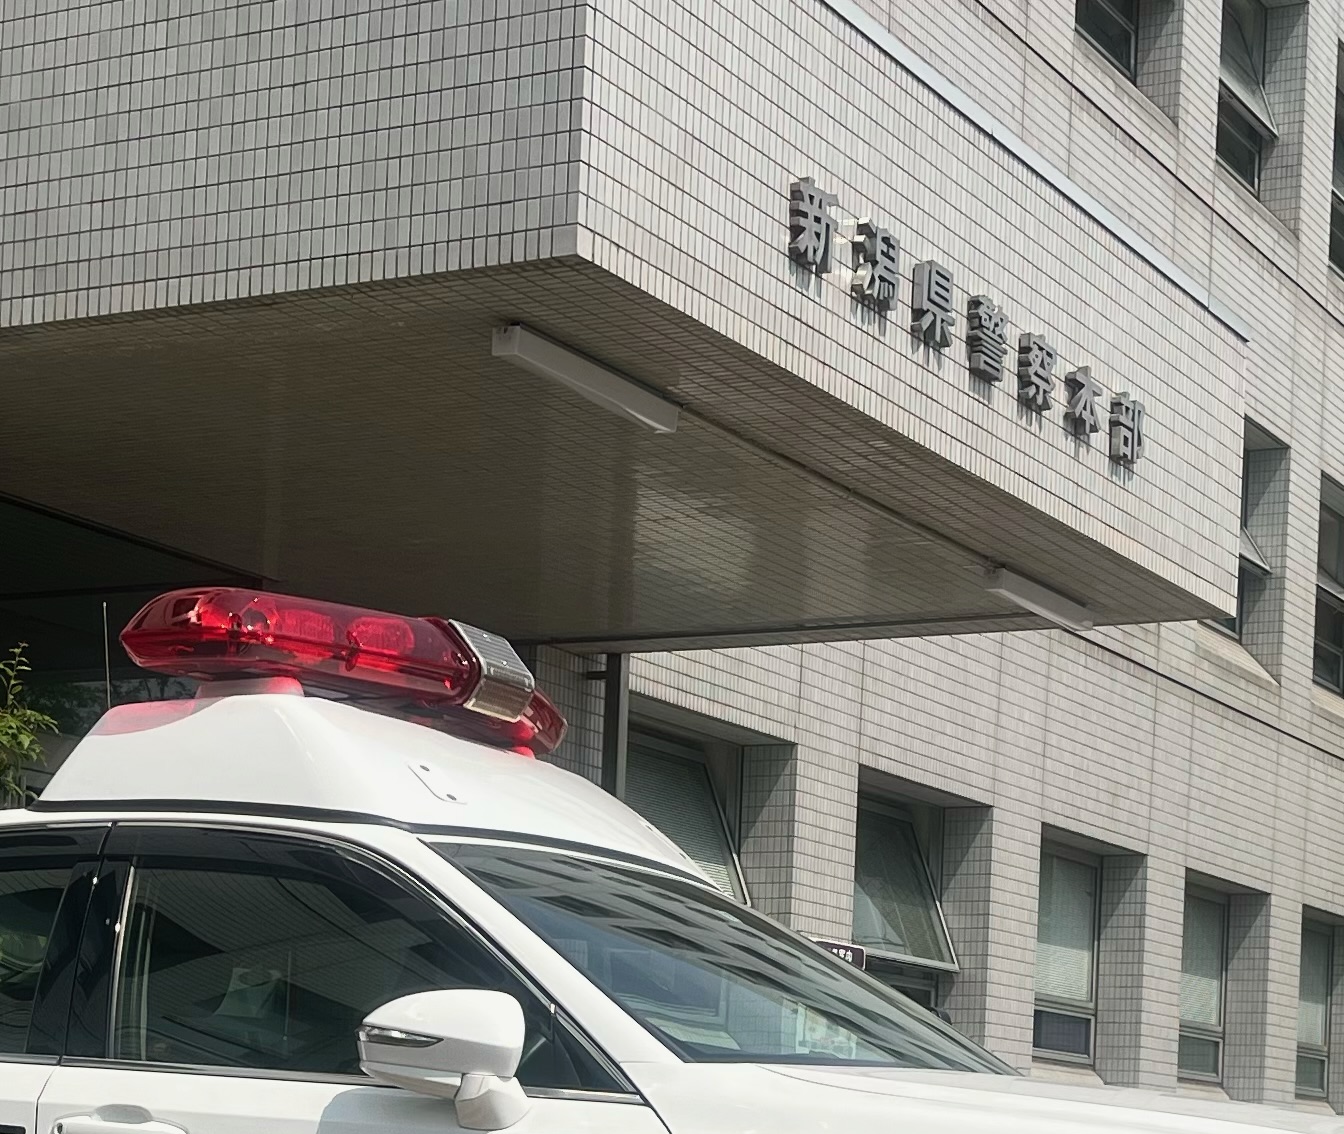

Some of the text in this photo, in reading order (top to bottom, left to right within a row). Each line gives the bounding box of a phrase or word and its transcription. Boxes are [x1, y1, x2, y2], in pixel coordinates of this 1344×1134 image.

[789, 177, 1146, 465] 新潟県警察本部
